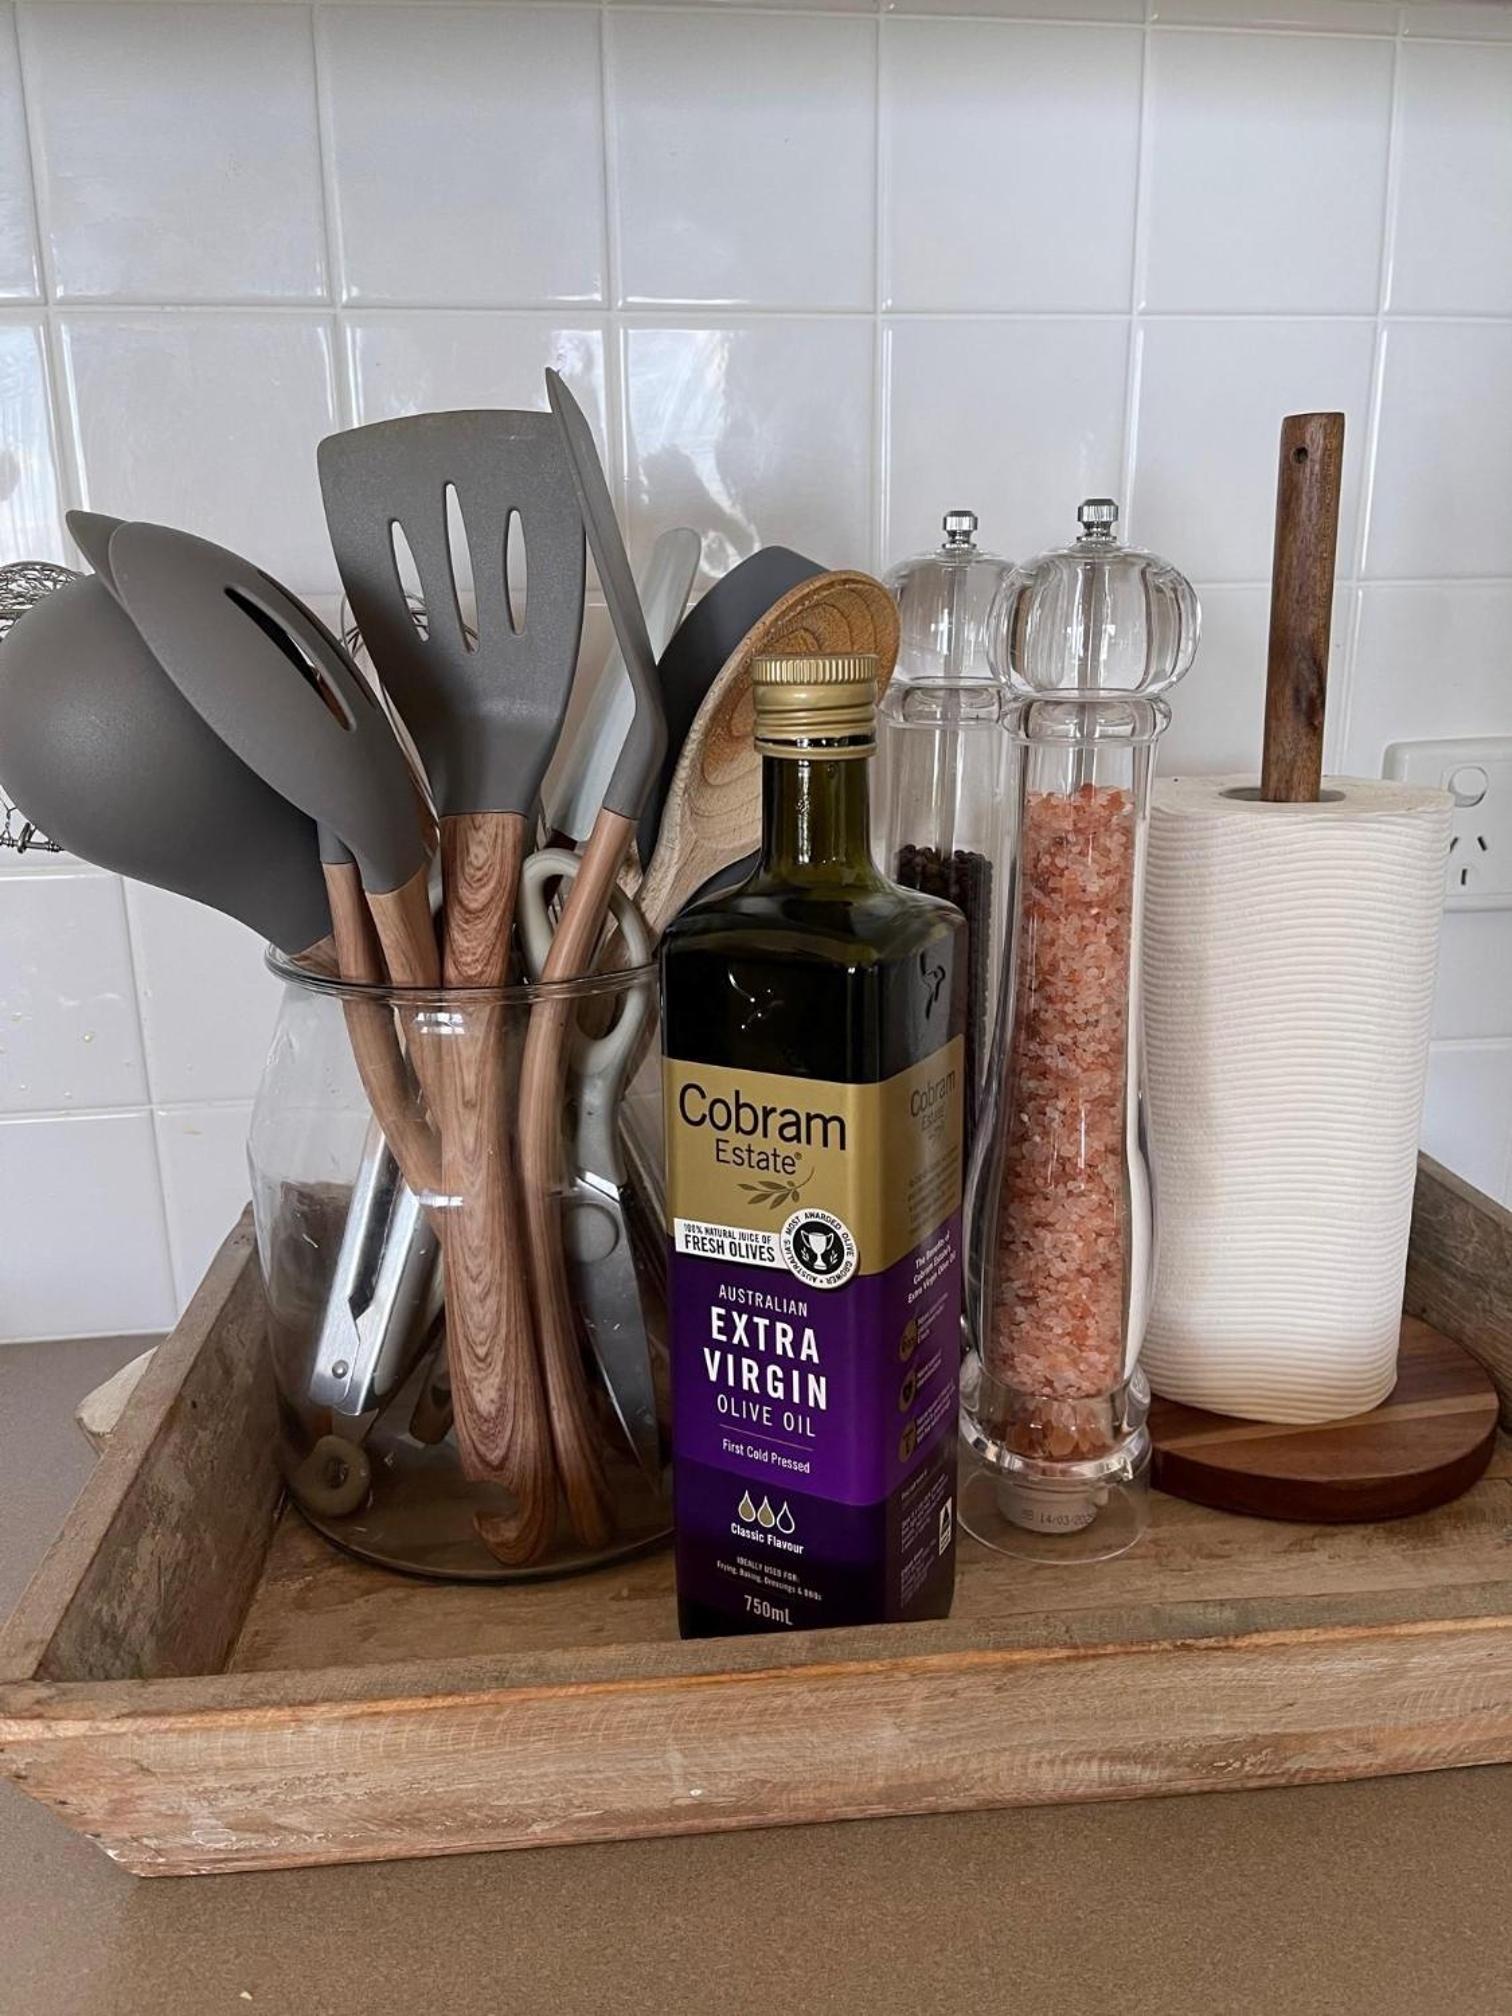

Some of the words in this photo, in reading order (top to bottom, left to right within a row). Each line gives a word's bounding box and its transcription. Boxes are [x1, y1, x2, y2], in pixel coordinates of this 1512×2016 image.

[910, 1069, 956, 1118] Cobram
[679, 1082, 847, 1151] Cobram
[683, 1222, 703, 1234] 100%
[704, 1226, 736, 1240] NATURAL
[738, 1230, 760, 1243] JUICE
[761, 1234, 772, 1244] OF
[785, 1216, 801, 1236] MOST
[804, 1212, 842, 1230] AWARDED
[684, 1234, 725, 1256] FRESH
[729, 1241, 775, 1263] OLIVES
[719, 1284, 808, 1317] AUSTRALIAN
[710, 1305, 820, 1364] EXTRA
[703, 1347, 827, 1411] VIRGIN
[717, 1393, 773, 1426] OLIVE
[783, 1412, 816, 1438] OIL
[722, 1438, 744, 1456] First
[746, 1445, 769, 1463] Cold
[771, 1452, 810, 1474] Pressed
[730, 1522, 765, 1543] Classic
[767, 1534, 805, 1555] Flavour
[743, 1594, 794, 1626] 750mL
